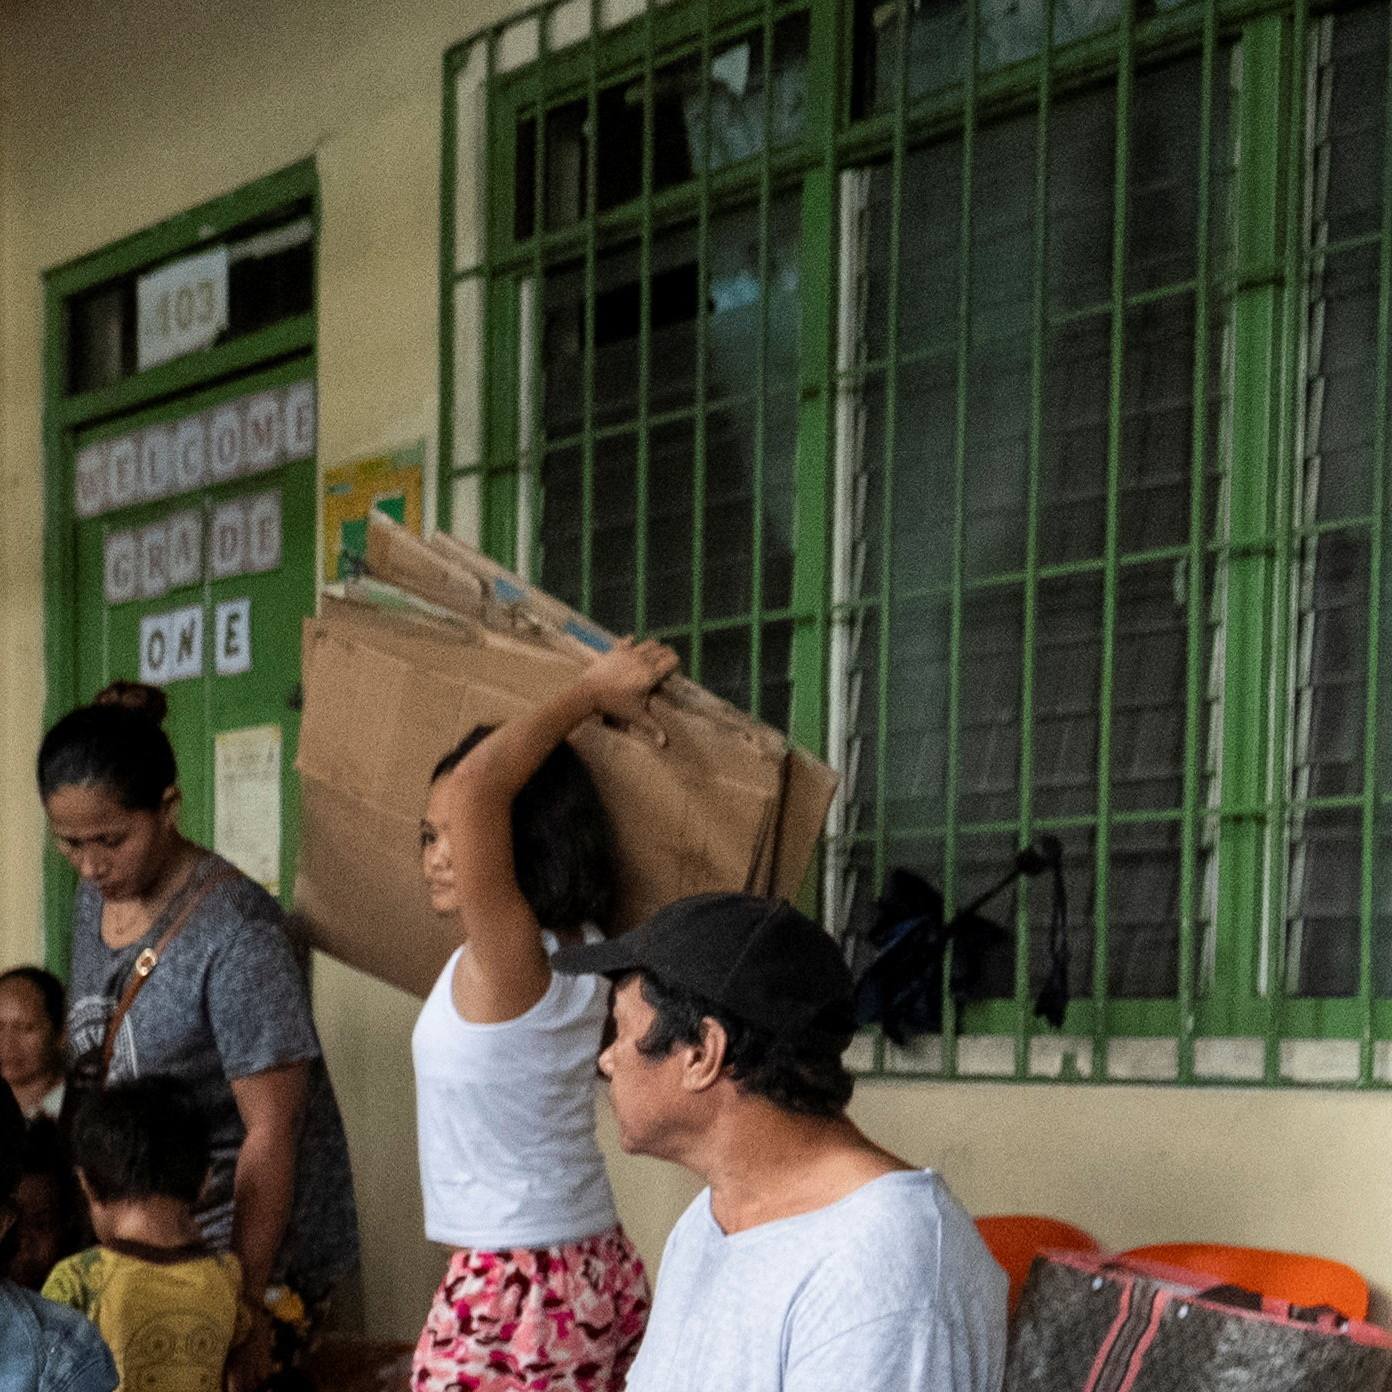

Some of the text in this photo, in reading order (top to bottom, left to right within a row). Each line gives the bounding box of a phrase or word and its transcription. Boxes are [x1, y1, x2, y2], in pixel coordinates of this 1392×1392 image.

[77, 402, 314, 505] WELCOME
[111, 515, 275, 587] GRADE
[147, 613, 242, 671] ONE
